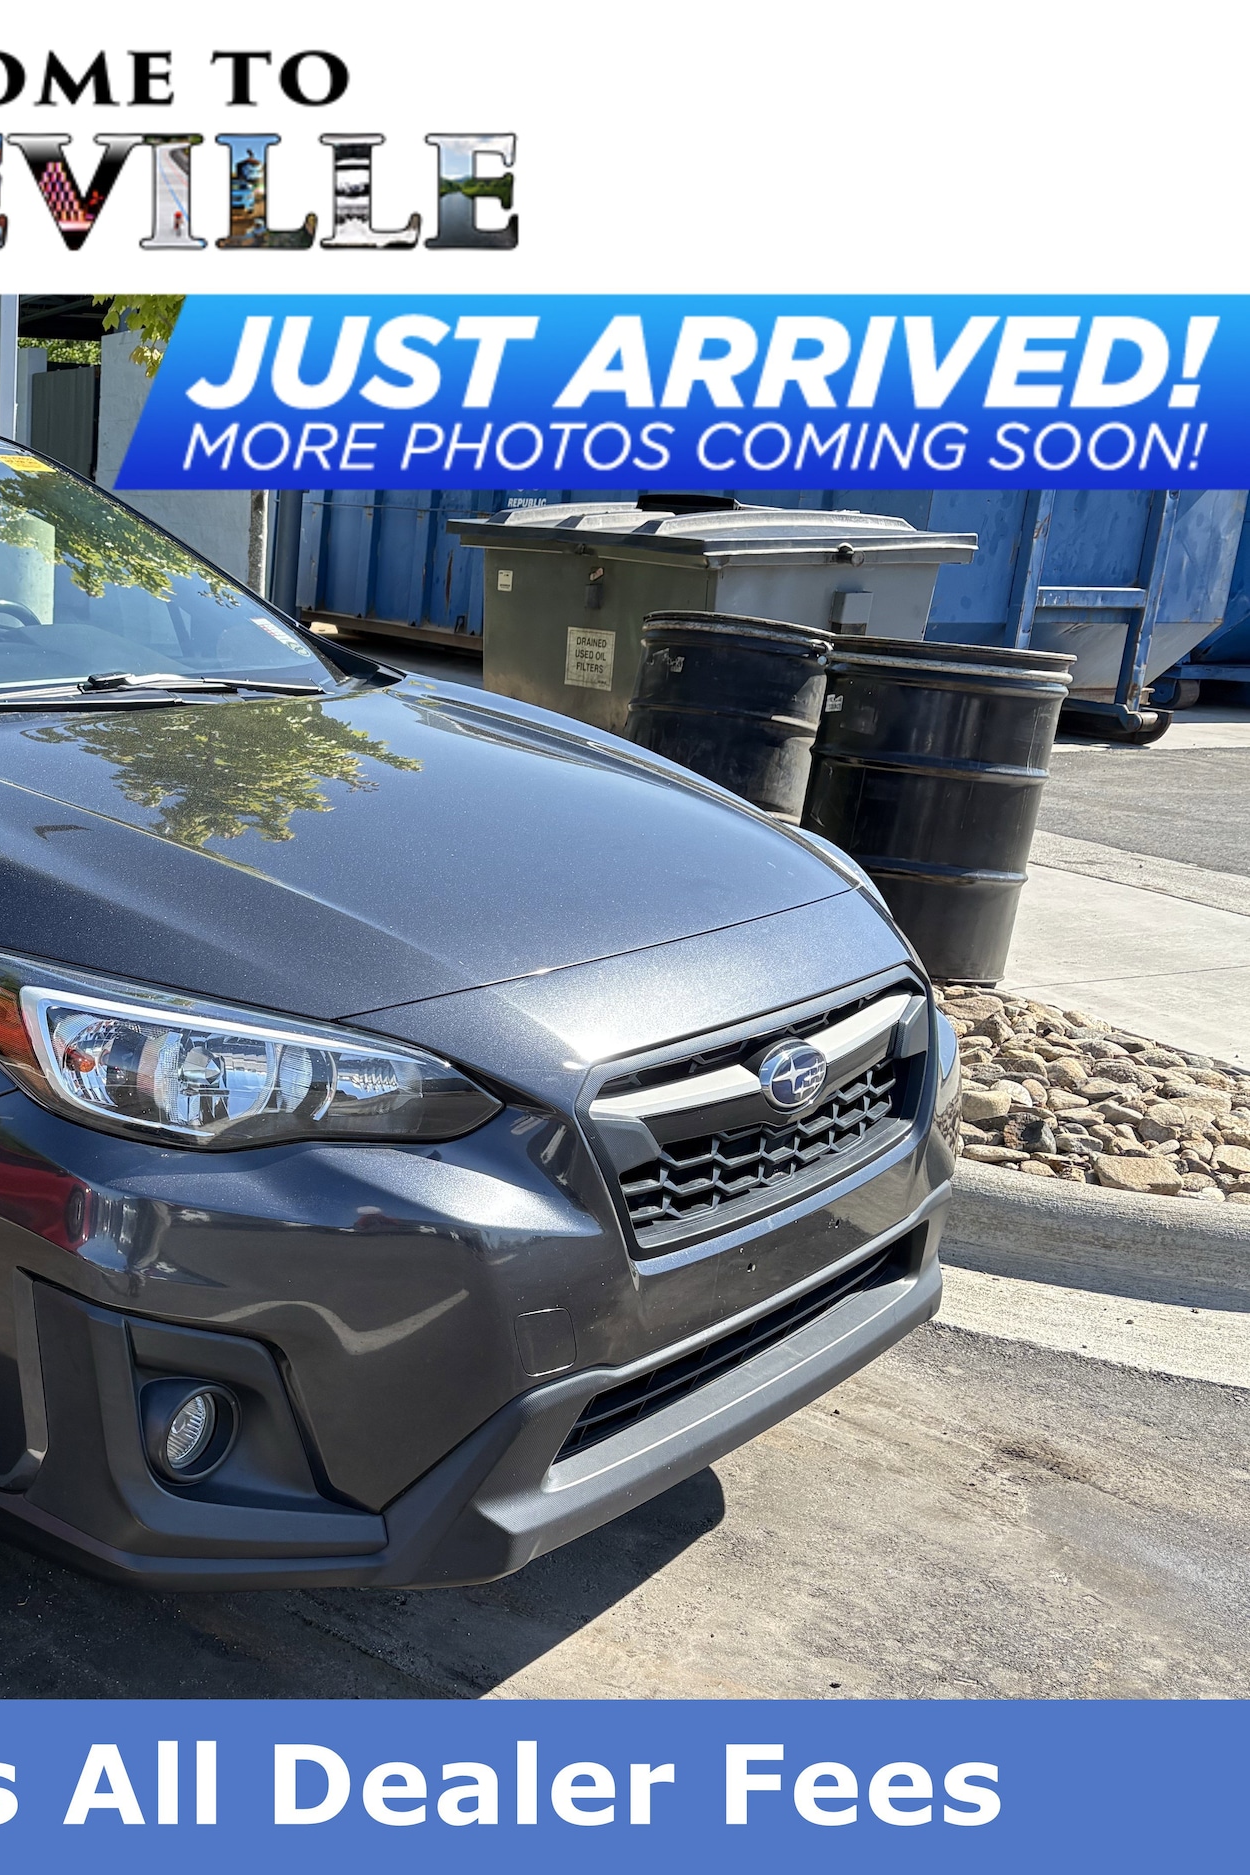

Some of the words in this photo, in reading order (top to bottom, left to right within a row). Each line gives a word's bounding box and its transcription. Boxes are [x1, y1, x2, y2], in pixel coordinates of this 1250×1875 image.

[507, 497, 547, 508] REPUBLIC
[576, 636, 607, 648] DRAINED
[575, 649, 593, 660] USED
[595, 651, 606, 661] OIL
[576, 661, 604, 674] FILTERS
